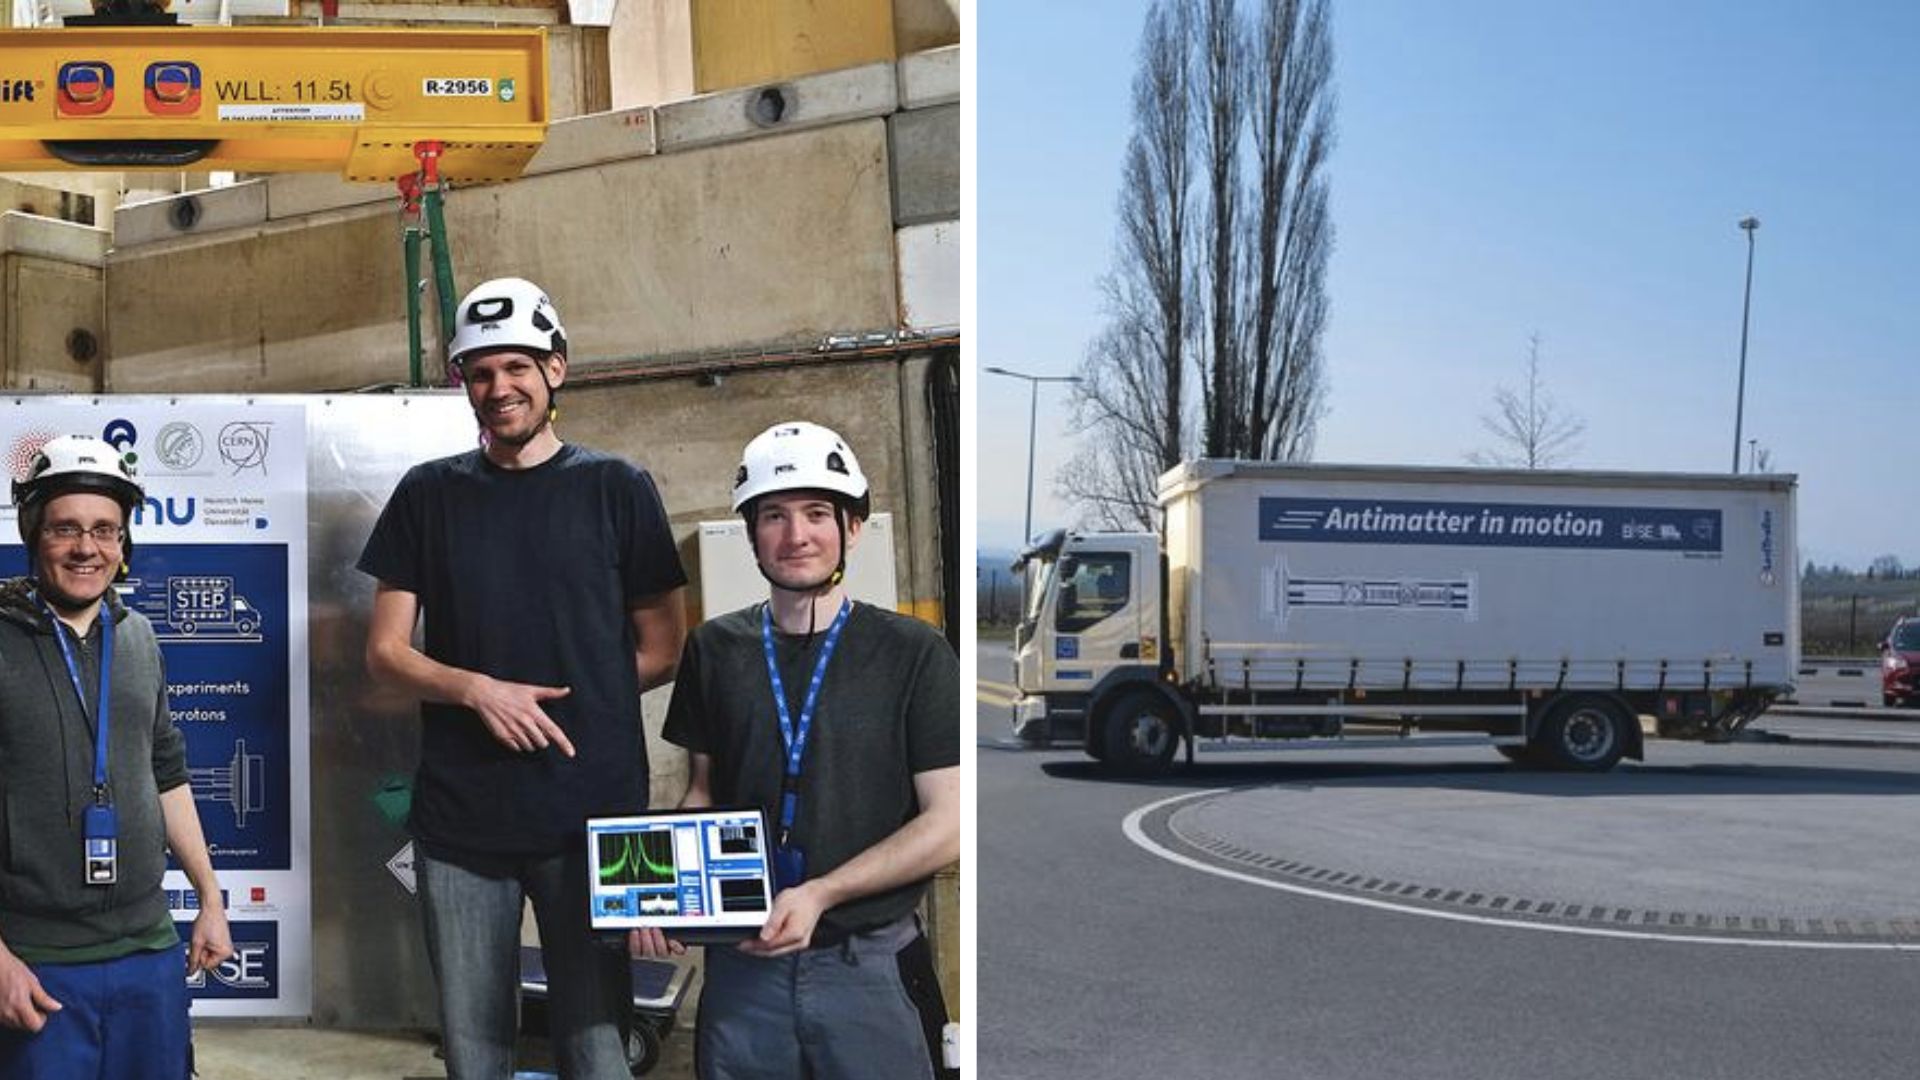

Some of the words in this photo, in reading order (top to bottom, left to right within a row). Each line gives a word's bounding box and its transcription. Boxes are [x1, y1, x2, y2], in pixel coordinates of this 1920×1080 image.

[216, 81, 281, 101] WLL:
[292, 81, 352, 101] 11.5t
[426, 80, 489, 94] R-2956
[222, 437, 253, 446] CERN
[1324, 506, 1474, 533] Antimatter
[1480, 509, 1504, 533] in
[1511, 511, 1603, 536] motion
[177, 590, 225, 610] STEP
[167, 681, 250, 697] xperiments
